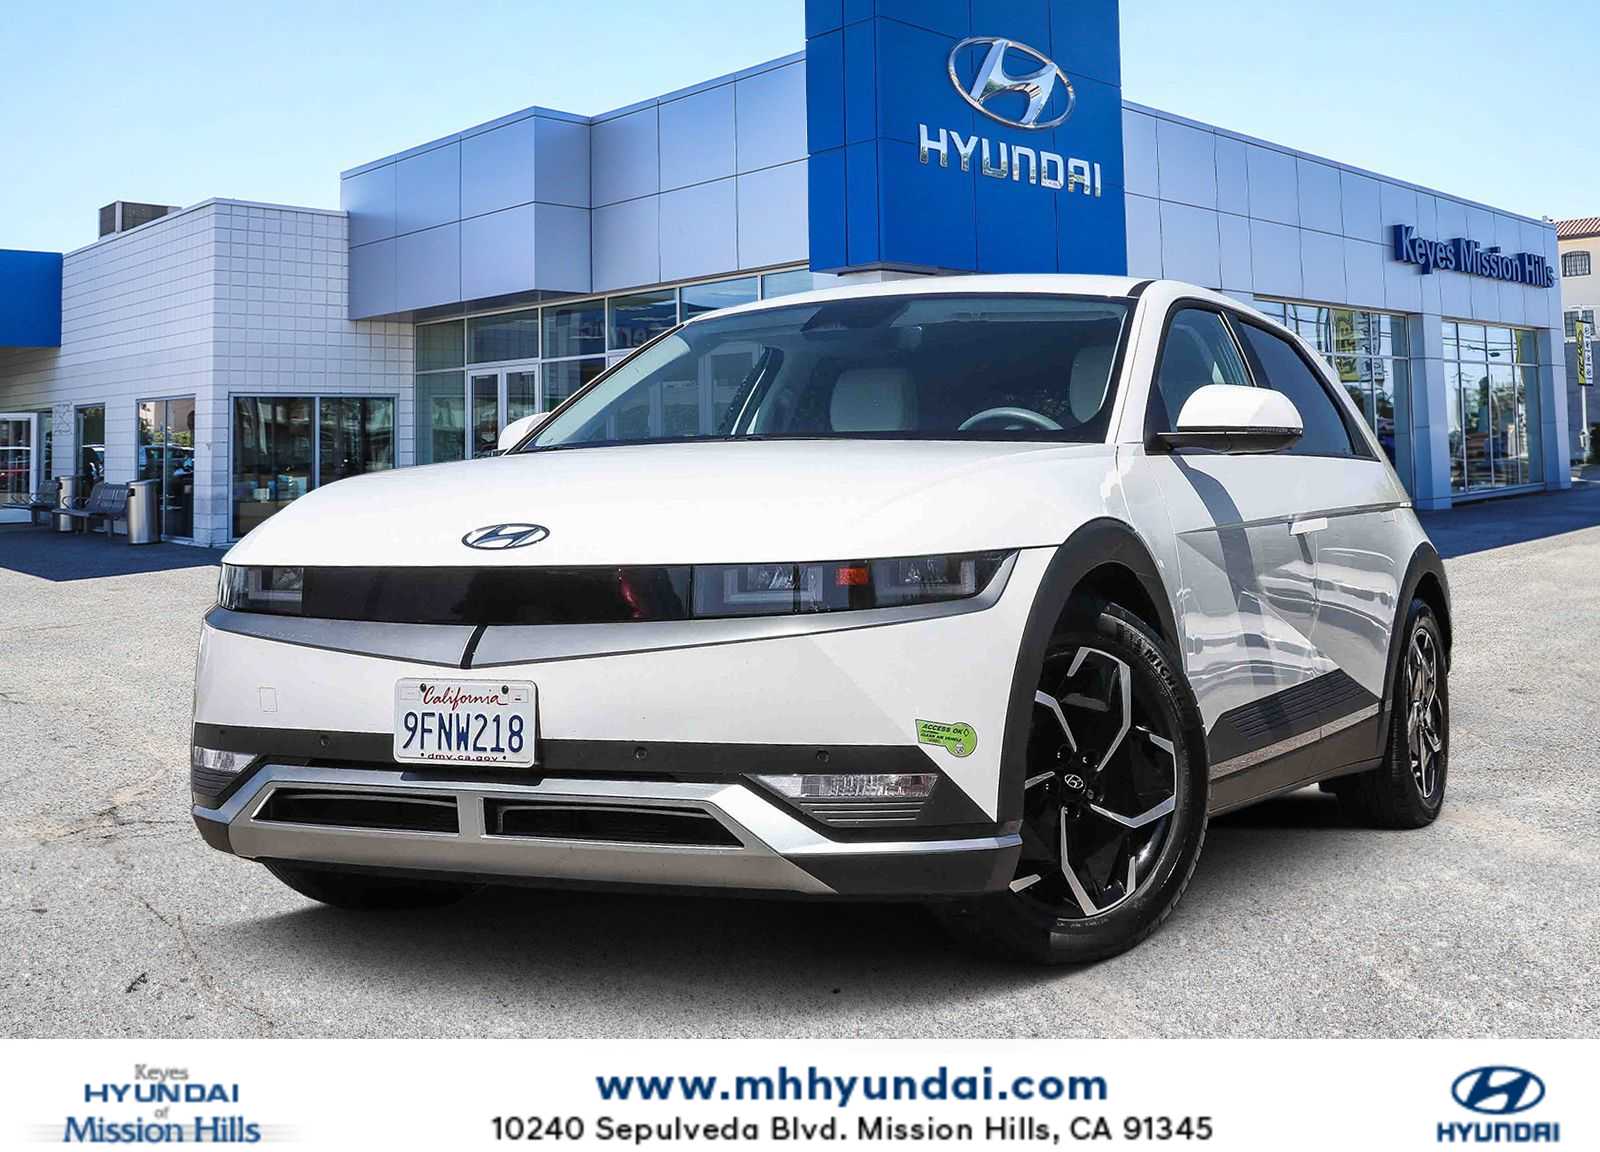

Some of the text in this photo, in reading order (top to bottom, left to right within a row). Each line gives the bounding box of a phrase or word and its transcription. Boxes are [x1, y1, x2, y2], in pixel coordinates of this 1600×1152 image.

[919, 123, 1102, 198] HYUNDAI
[1396, 224, 1555, 289] Keyes Mission Hills
[423, 685, 509, 711] California
[402, 711, 524, 753] 9FNW218
[921, 723, 951, 732] ACCESS
[952, 727, 963, 735] OK
[427, 752, 498, 763] dmv.ca.gov
